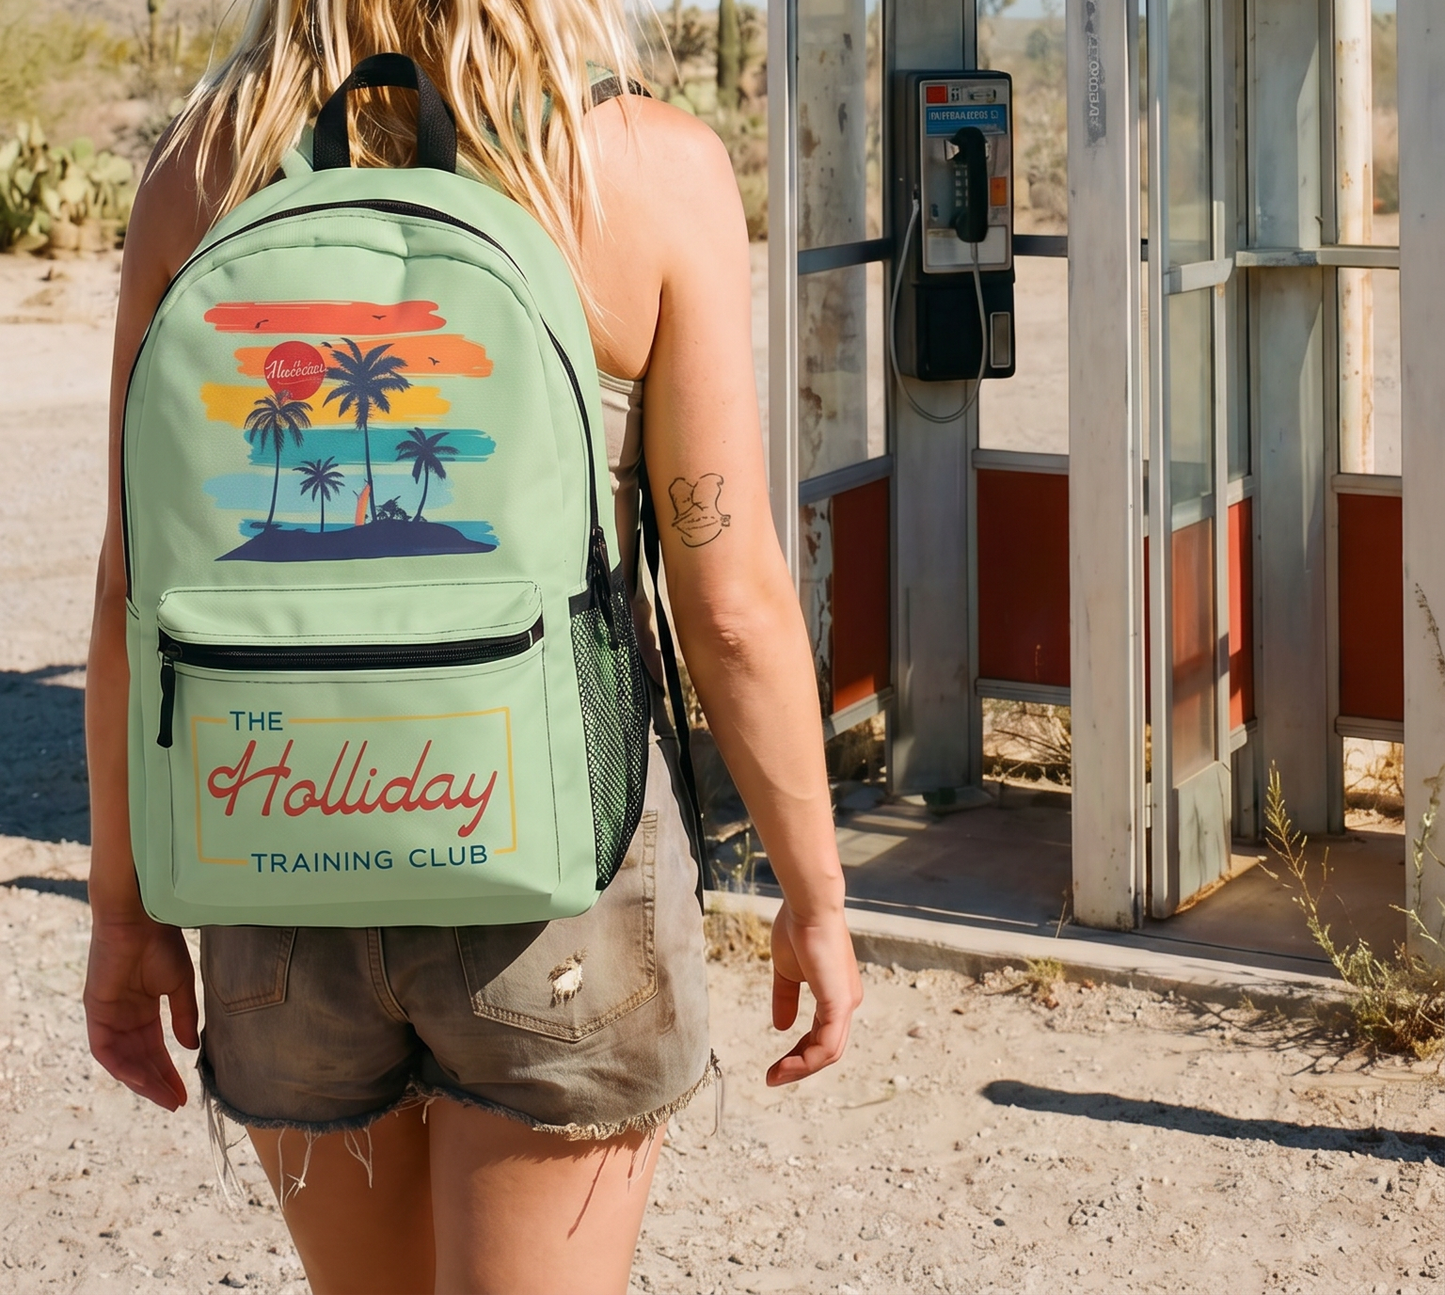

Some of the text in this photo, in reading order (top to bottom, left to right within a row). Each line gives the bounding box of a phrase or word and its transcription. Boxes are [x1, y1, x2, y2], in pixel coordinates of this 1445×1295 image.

[229, 710, 284, 731] THE
[206, 739, 498, 837] Holliday
[251, 844, 488, 873] TRAINING CLUB
